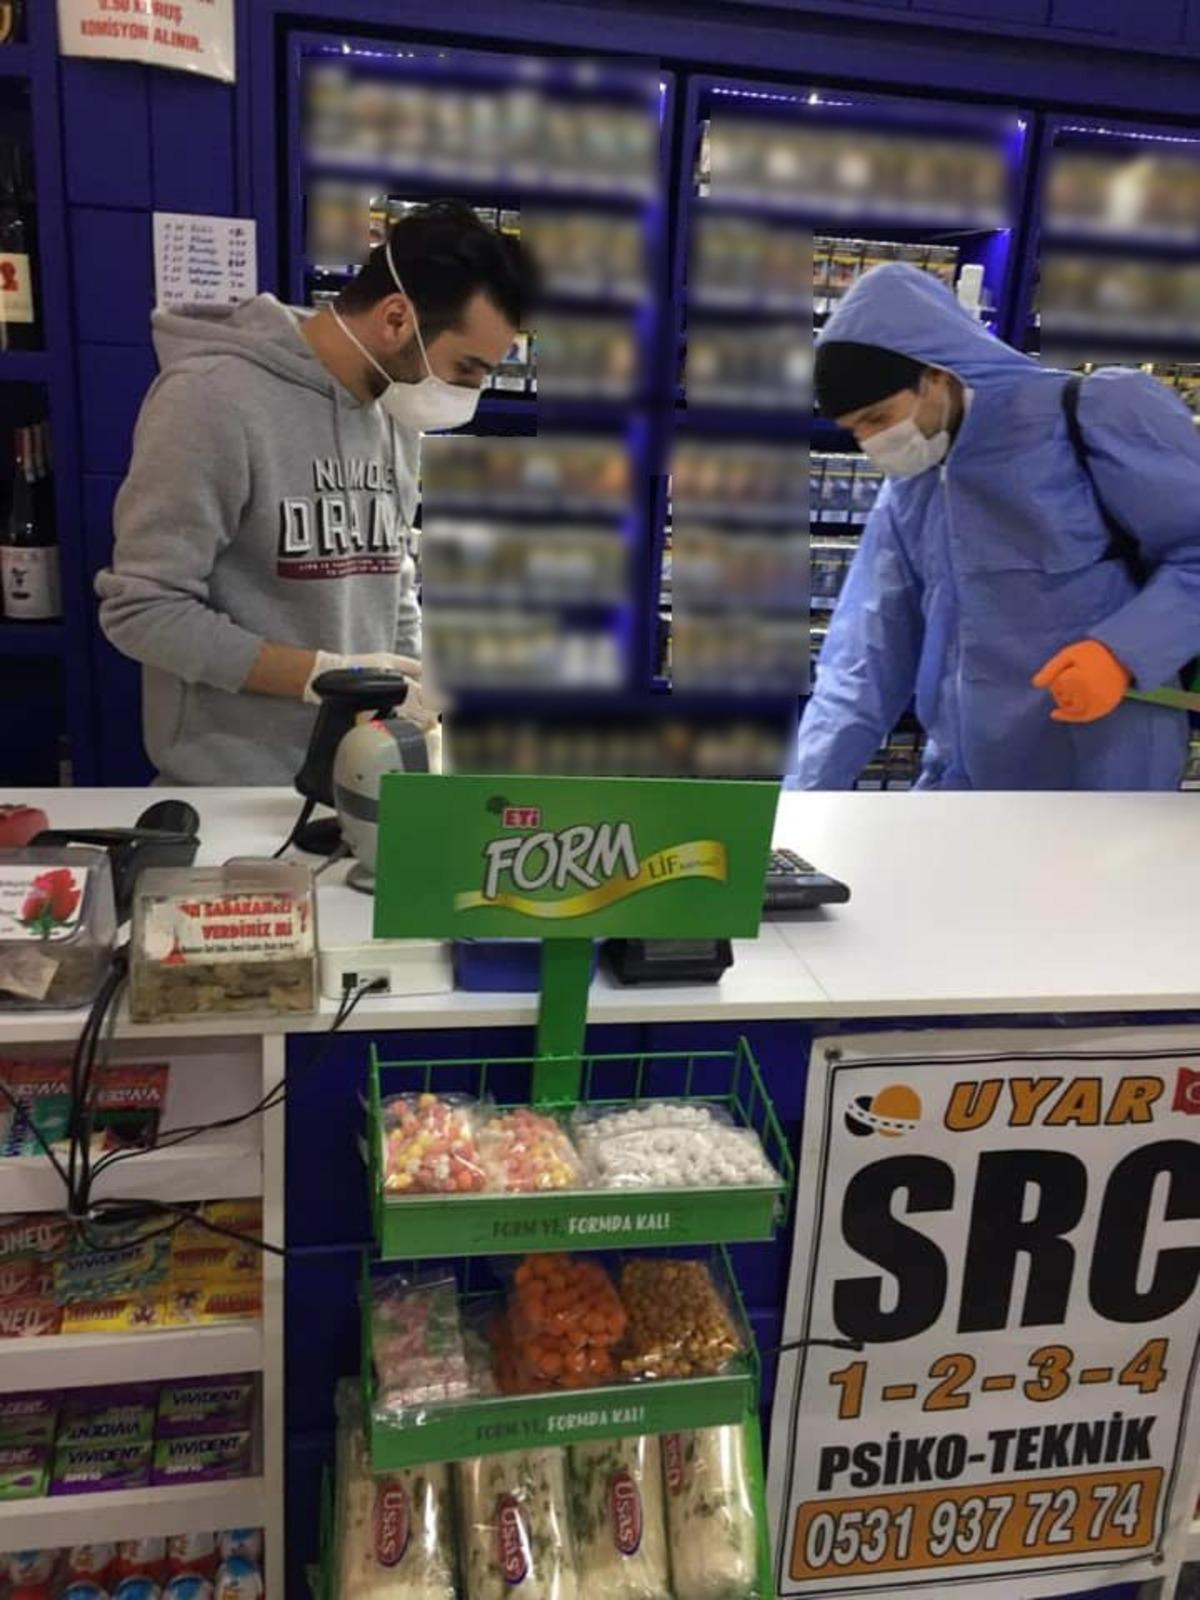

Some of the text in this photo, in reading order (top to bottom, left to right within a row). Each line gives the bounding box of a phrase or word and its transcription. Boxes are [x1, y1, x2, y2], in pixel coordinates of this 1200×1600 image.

[483, 821, 640, 900] FORM
[944, 1076, 1165, 1132] UYAR
[567, 1212, 633, 1236] FORMDA
[833, 1138, 1200, 1344] SRC
[817, 1412, 1157, 1491] PSİKO-TEKNİK
[804, 1480, 1144, 1570] 0531 937 72 74
